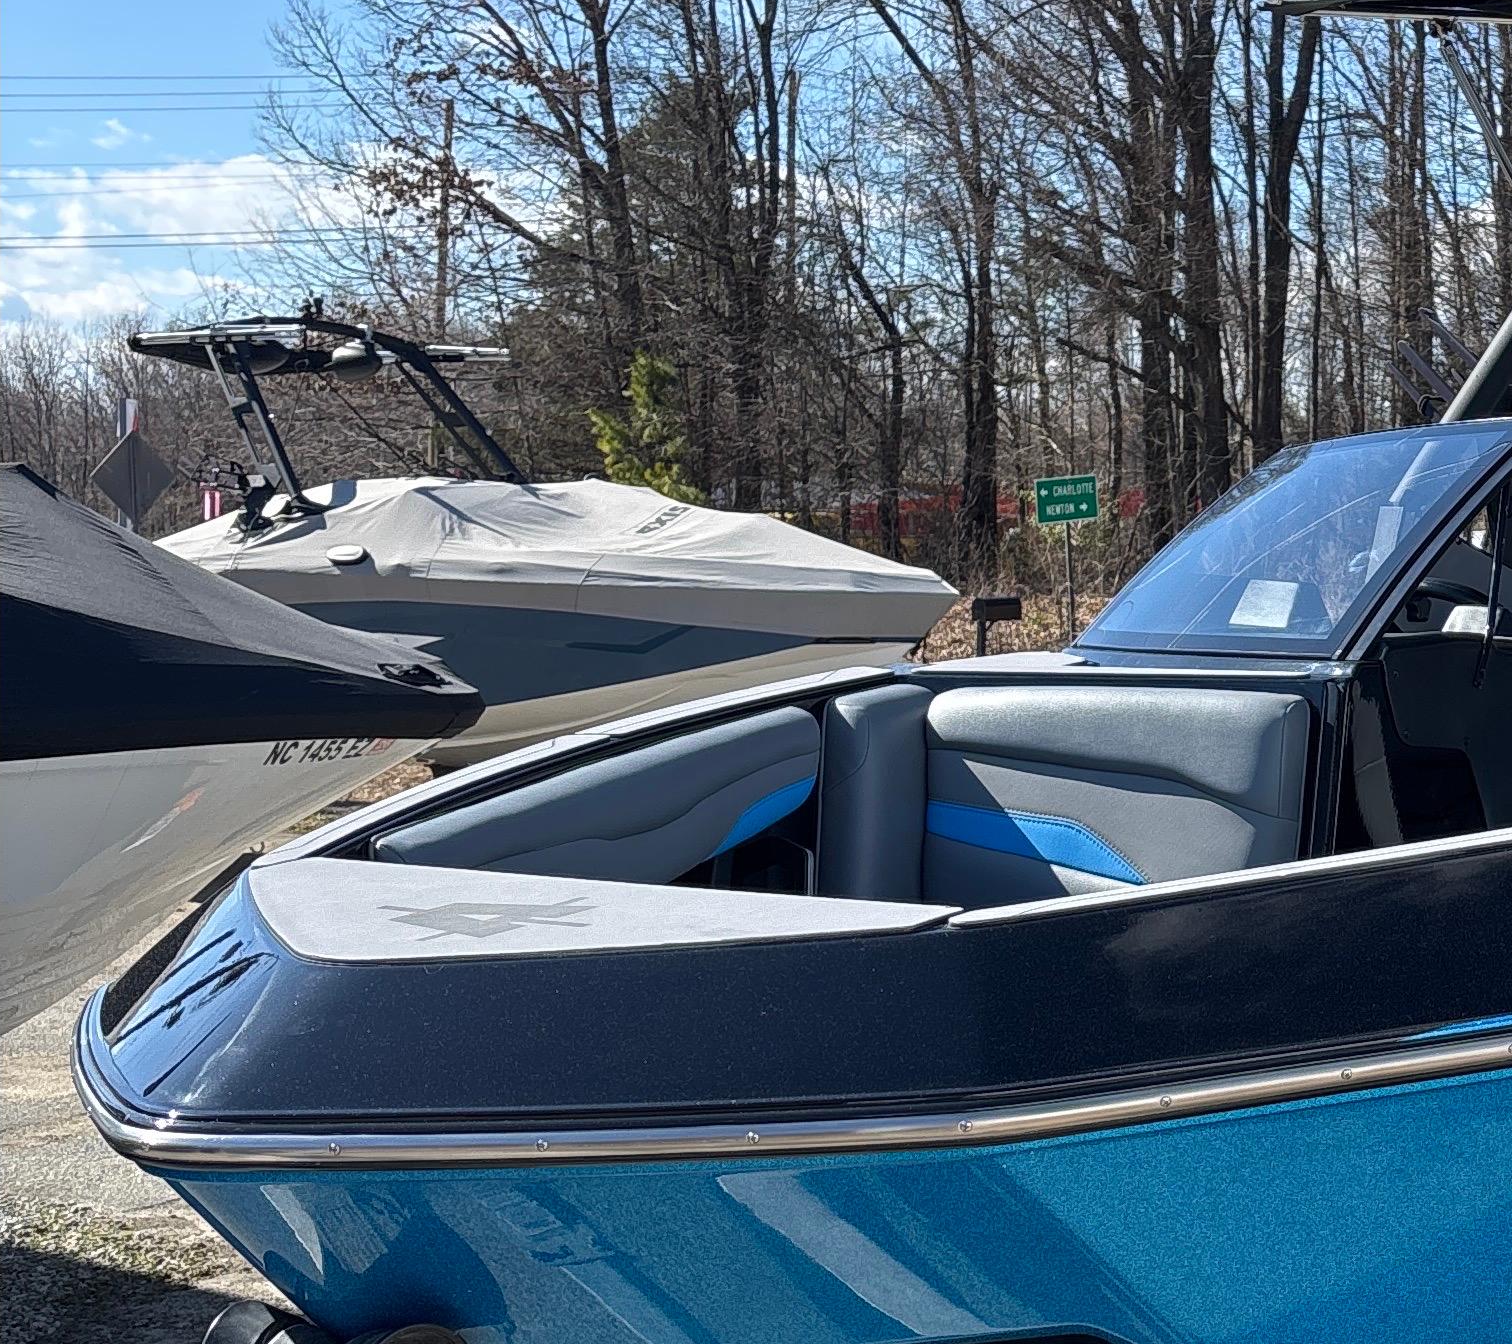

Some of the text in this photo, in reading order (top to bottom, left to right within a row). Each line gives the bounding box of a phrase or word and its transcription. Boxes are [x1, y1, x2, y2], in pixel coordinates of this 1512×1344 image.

[1052, 481, 1095, 497] CHARLOTTE
[1046, 502, 1075, 516] NEWTON
[263, 741, 299, 765] NC
[298, 739, 349, 763] 1455
